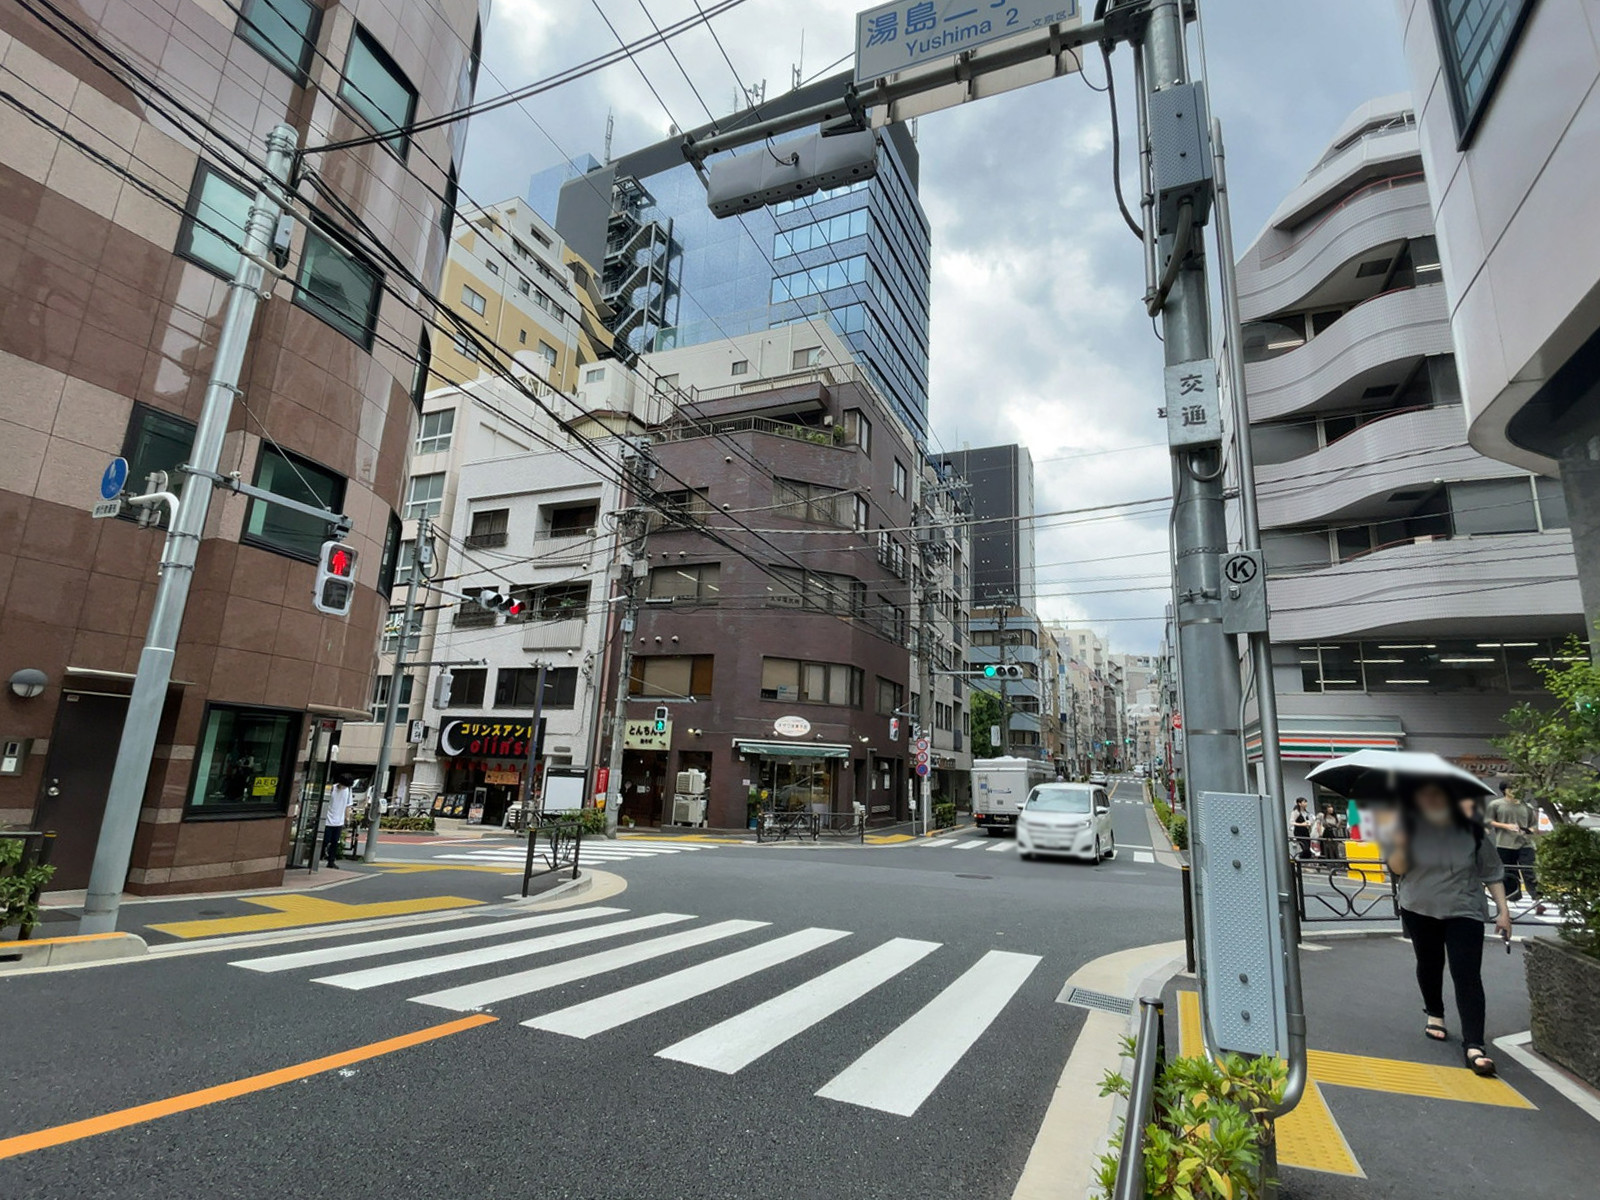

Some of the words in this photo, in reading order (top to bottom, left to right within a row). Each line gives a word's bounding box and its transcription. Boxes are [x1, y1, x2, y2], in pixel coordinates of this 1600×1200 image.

[905, 19, 992, 57] Yushima
[1006, 8, 1019, 26] 2
[1031, 10, 1067, 29] 文京区
[1179, 374, 1208, 427] 交通
